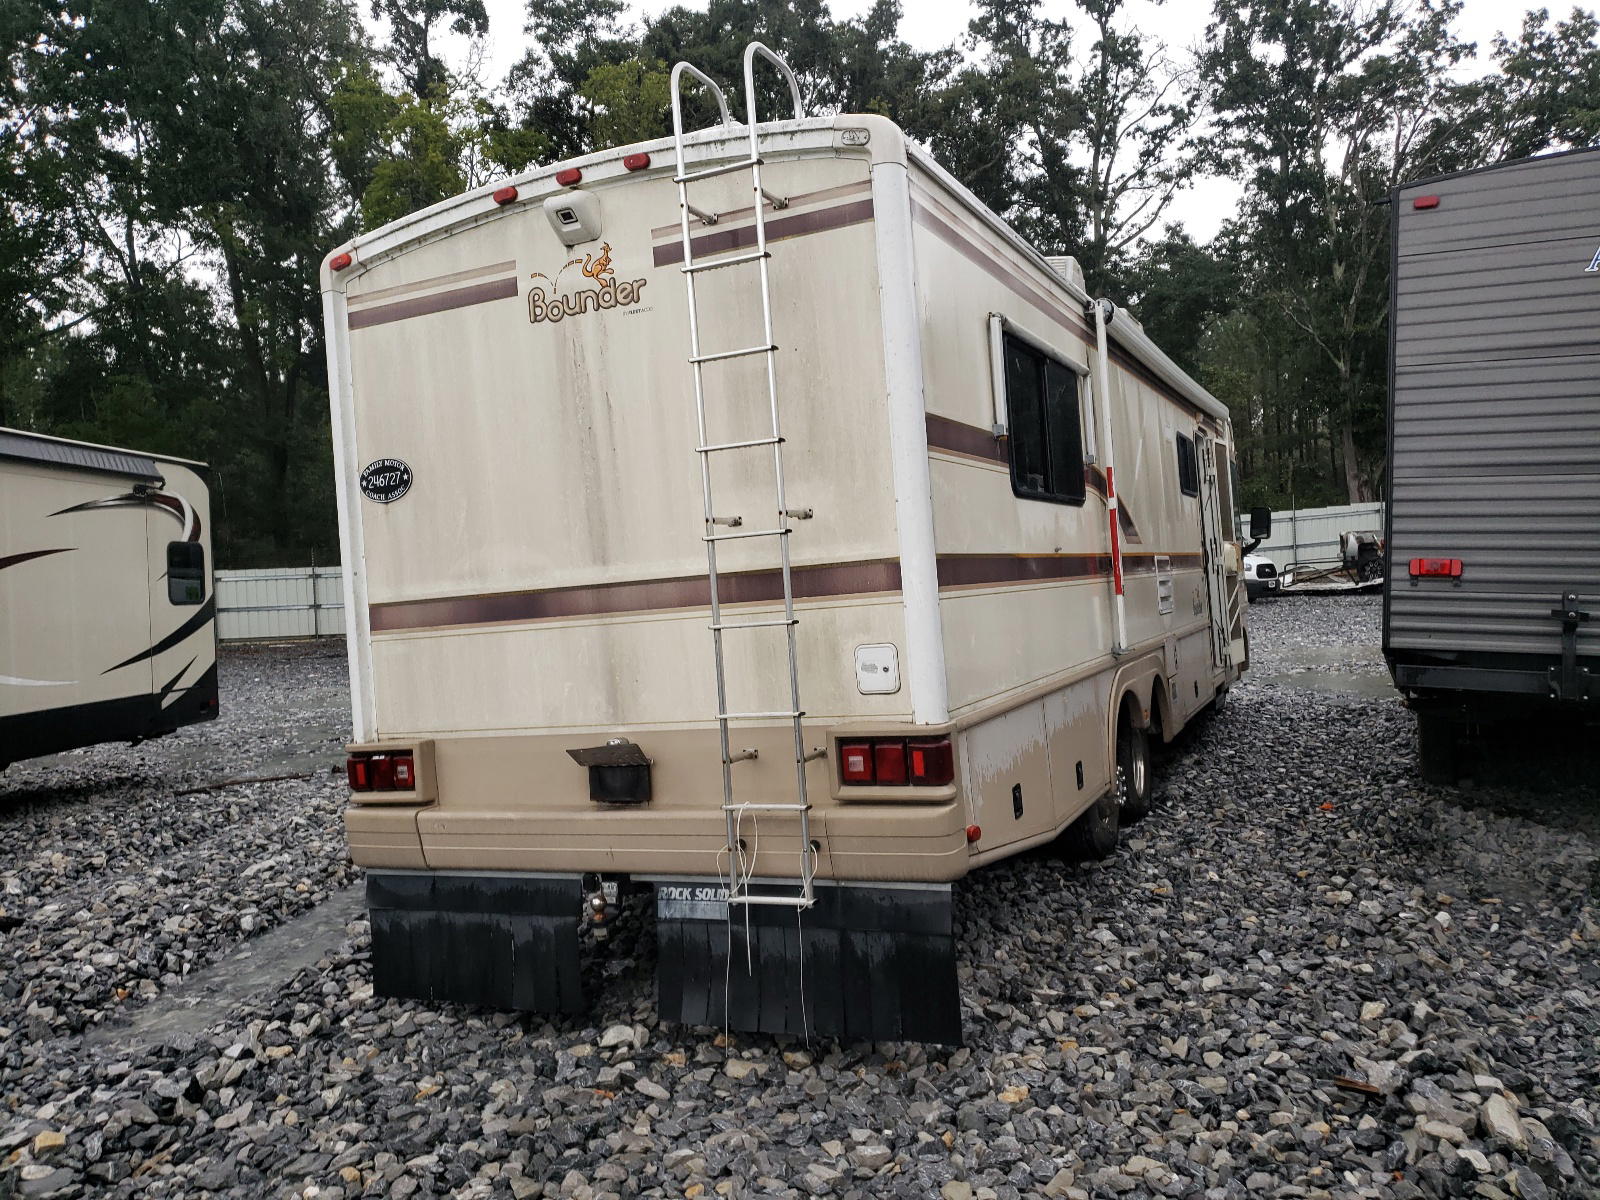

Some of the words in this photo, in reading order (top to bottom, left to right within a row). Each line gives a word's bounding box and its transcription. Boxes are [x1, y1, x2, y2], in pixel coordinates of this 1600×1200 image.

[528, 277, 647, 323] Bounder
[363, 460, 383, 477] FAMILY
[384, 459, 405, 471] MOTOR
[368, 471, 401, 489] 246727
[365, 490, 386, 501] COACH
[657, 886, 692, 901] ROCK
[694, 887, 730, 901] SOLID
